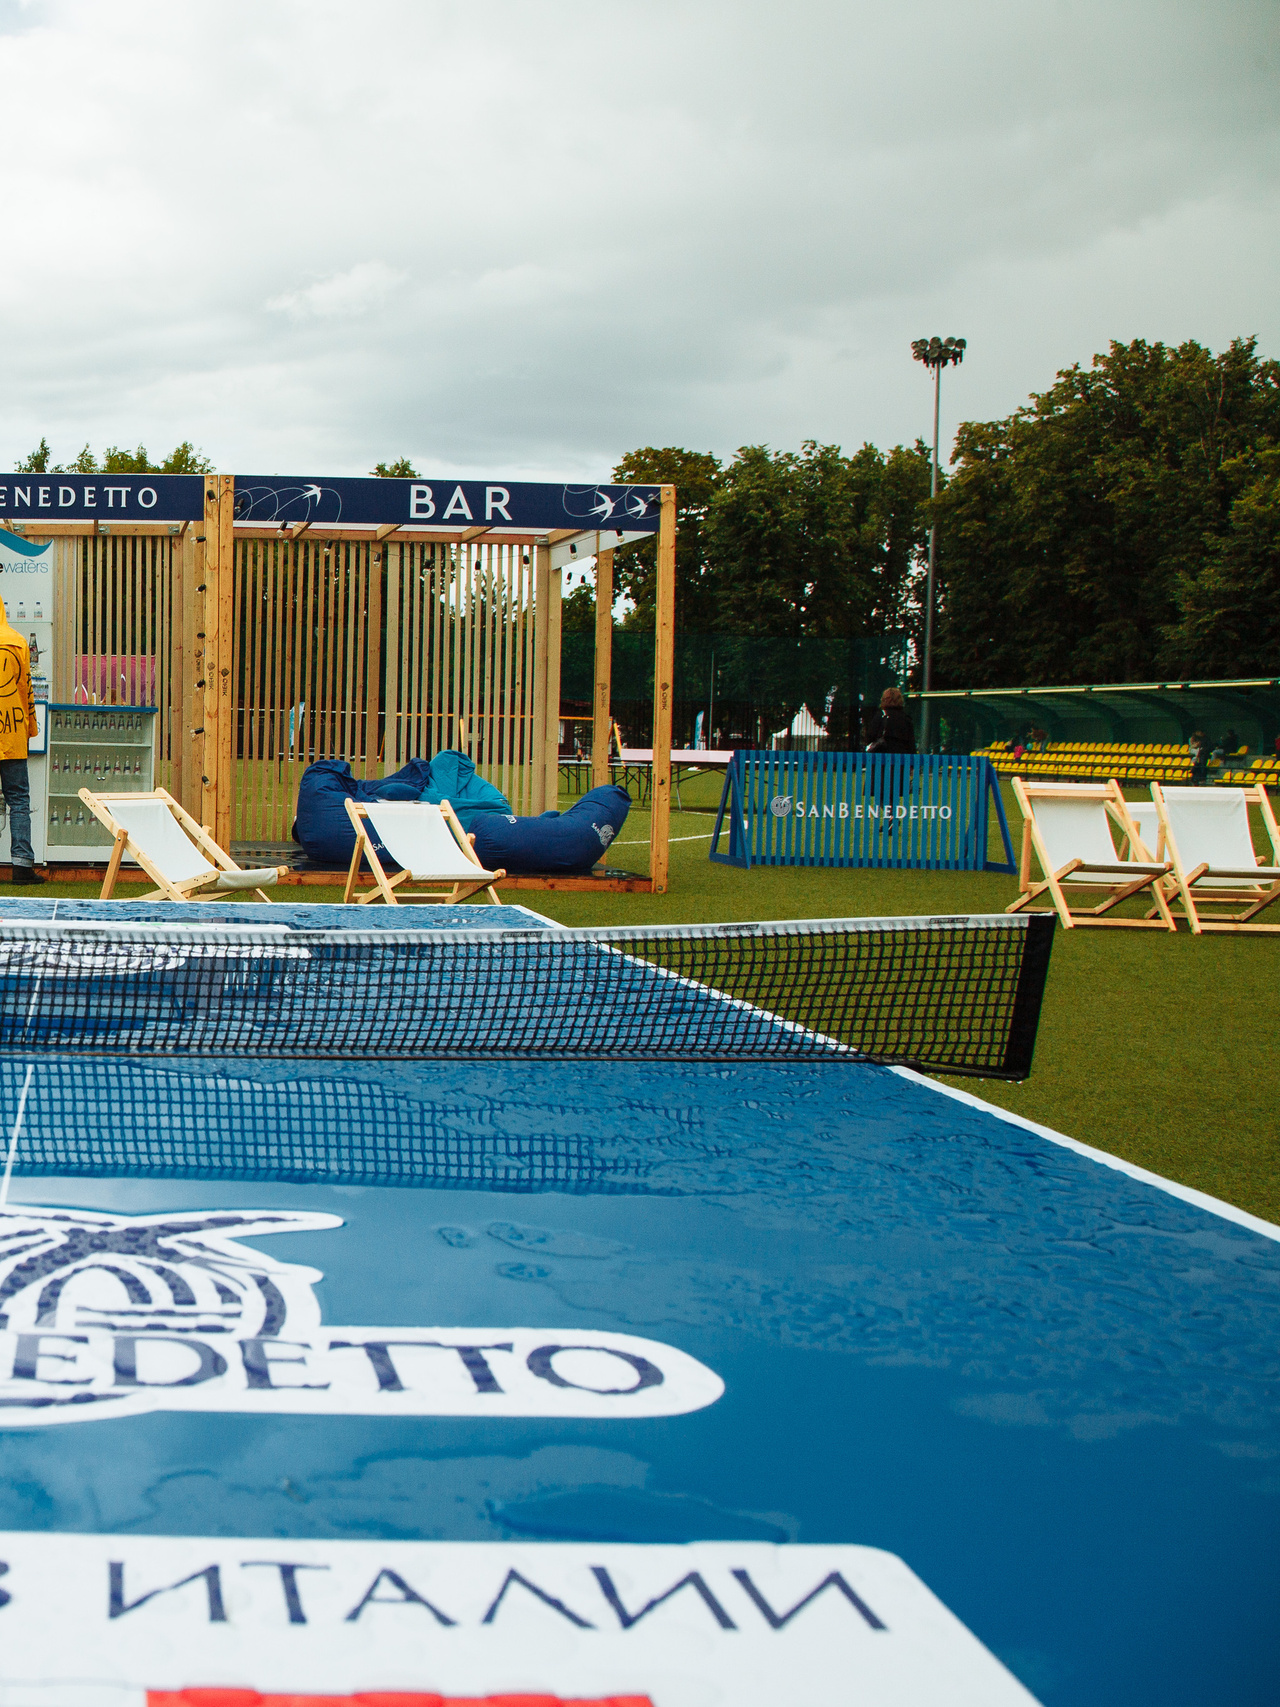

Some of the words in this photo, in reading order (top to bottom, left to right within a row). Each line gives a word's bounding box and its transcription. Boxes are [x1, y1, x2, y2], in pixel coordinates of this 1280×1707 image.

[409, 484, 513, 521] BAR
[795, 801, 952, 820] SANBENEDETTO
[107, 1560, 888, 1633] ИТАЛИИ
